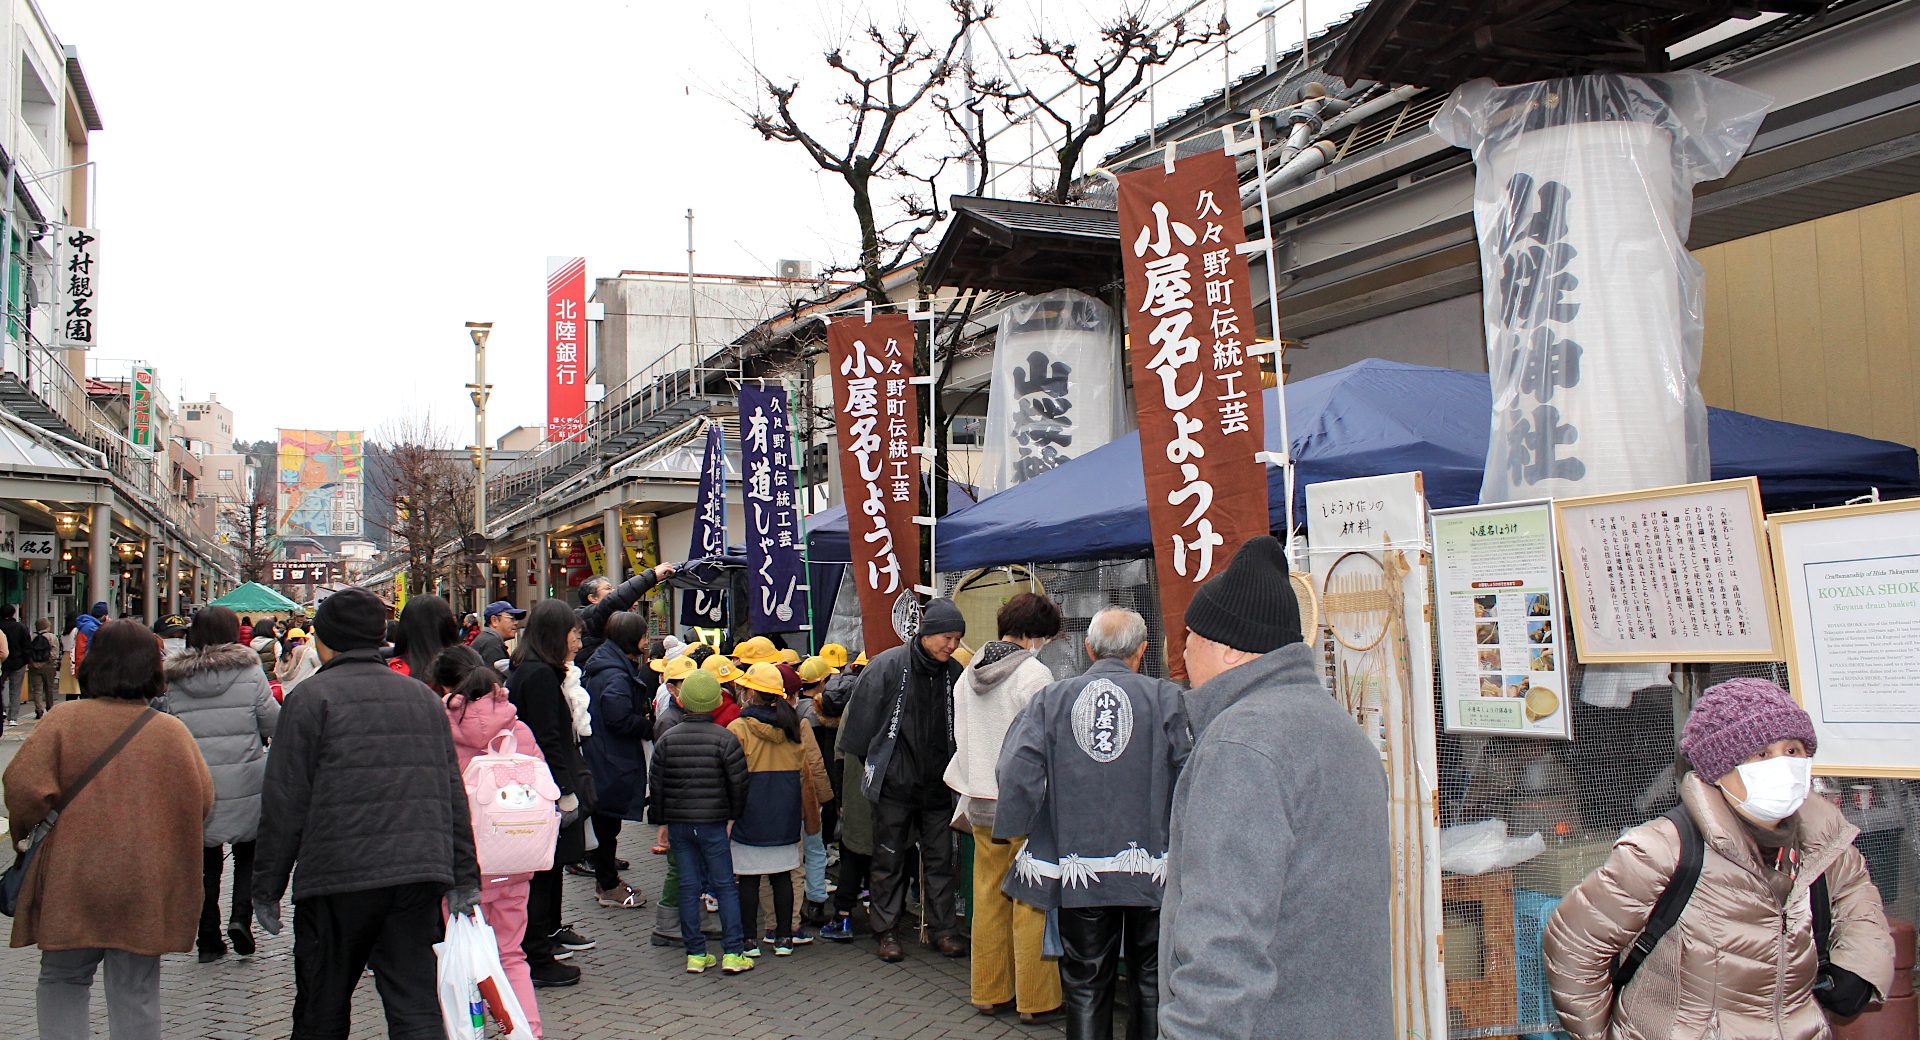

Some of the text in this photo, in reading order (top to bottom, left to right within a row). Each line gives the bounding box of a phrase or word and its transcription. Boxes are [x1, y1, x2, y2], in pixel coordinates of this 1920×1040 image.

[65, 230, 95, 342] 中村観石園
[555, 298, 577, 385] 北陸銀行
[1196, 188, 1250, 436] 久々野町伝統工芸
[135, 390, 151, 444] フジカラー
[884, 337, 910, 503] 久々野町伝統工芸
[1133, 201, 1224, 581] 小屋名しょうけ
[745, 406, 778, 617] 有道しゃくし
[770, 396, 793, 549] 久々野町伝統工芸
[840, 340, 902, 594] 小屋名しょうけ
[1339, 518, 1372, 537] 材料
[1470, 523, 1518, 537] 小屋名しょうけ
[1818, 585, 1876, 599] KOYANA
[1093, 693, 1116, 753] 小屋名
